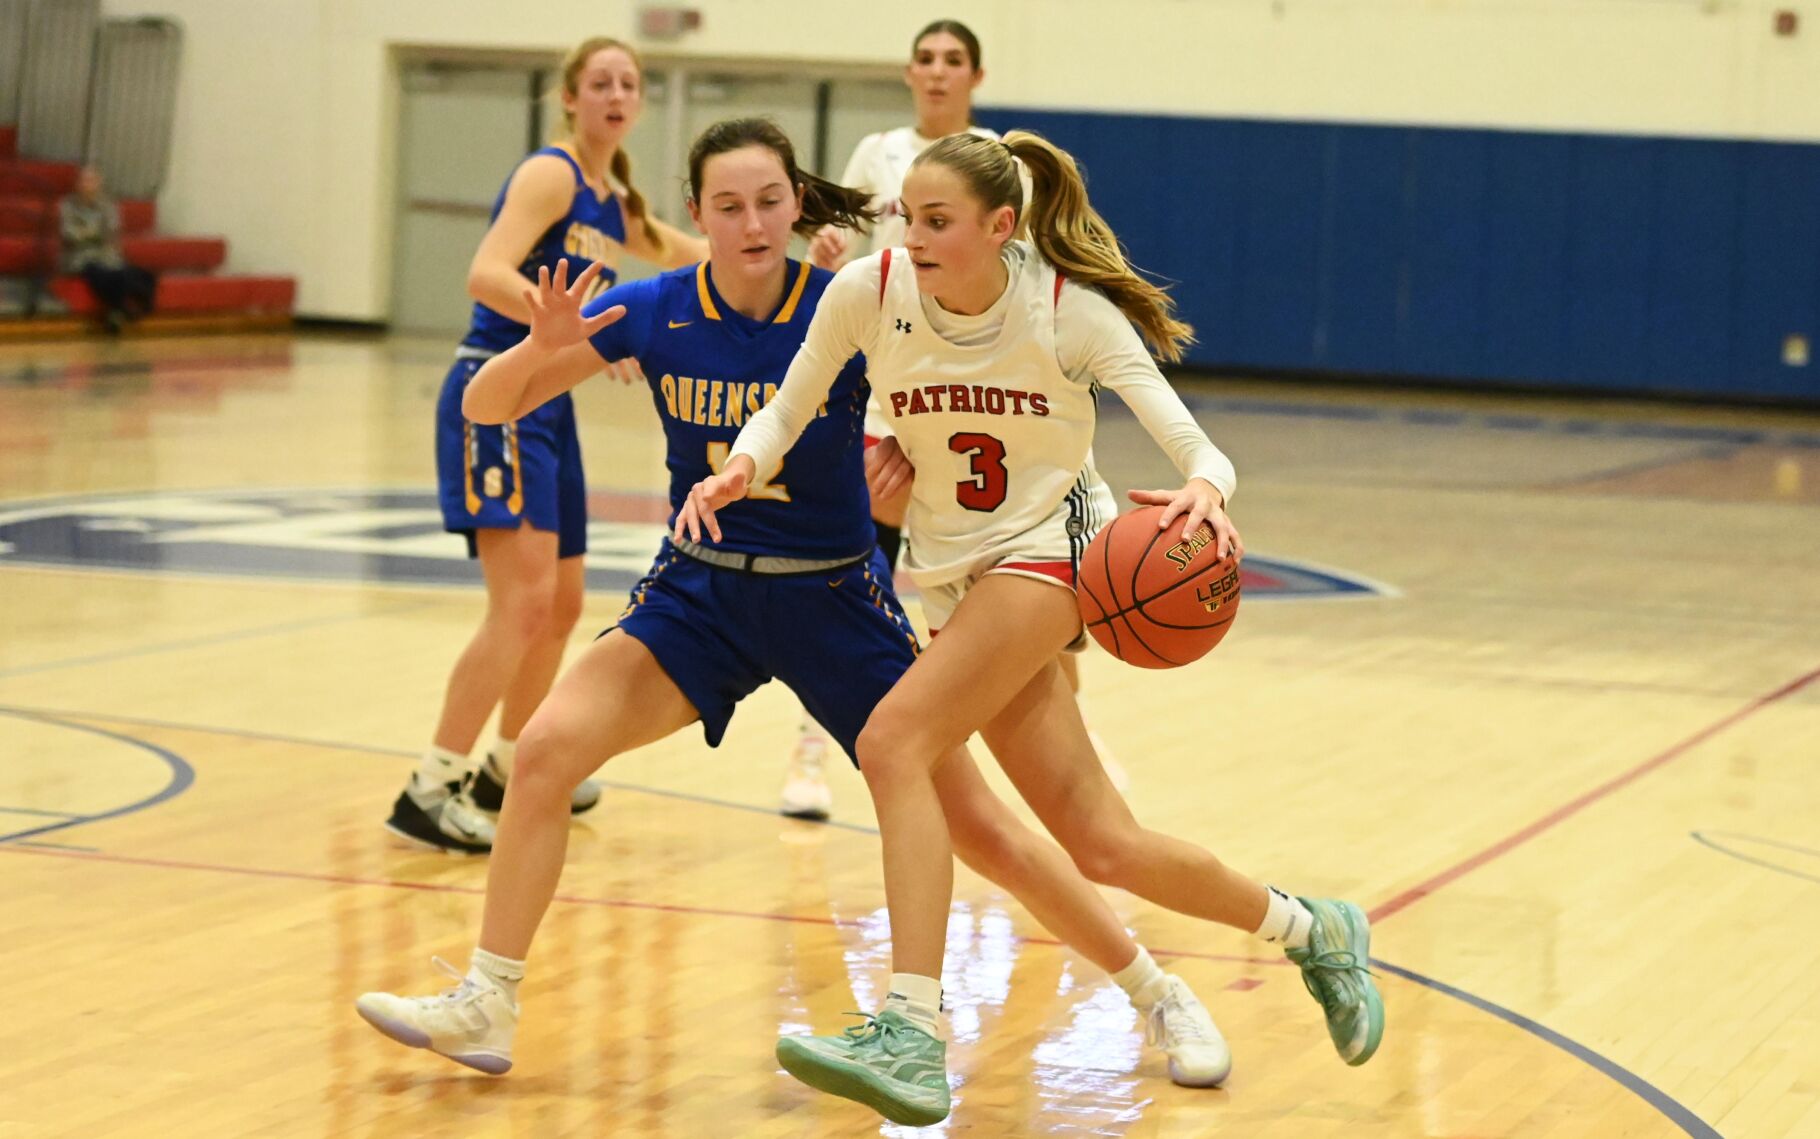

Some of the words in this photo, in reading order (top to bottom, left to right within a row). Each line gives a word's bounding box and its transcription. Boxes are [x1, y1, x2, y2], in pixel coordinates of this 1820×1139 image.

[660, 373, 829, 427] QUEENS
[889, 384, 1050, 418] PATRIOTS
[948, 431, 1008, 513] 3
[1165, 525, 1216, 573] SPALD
[1196, 566, 1240, 602] LEGA
